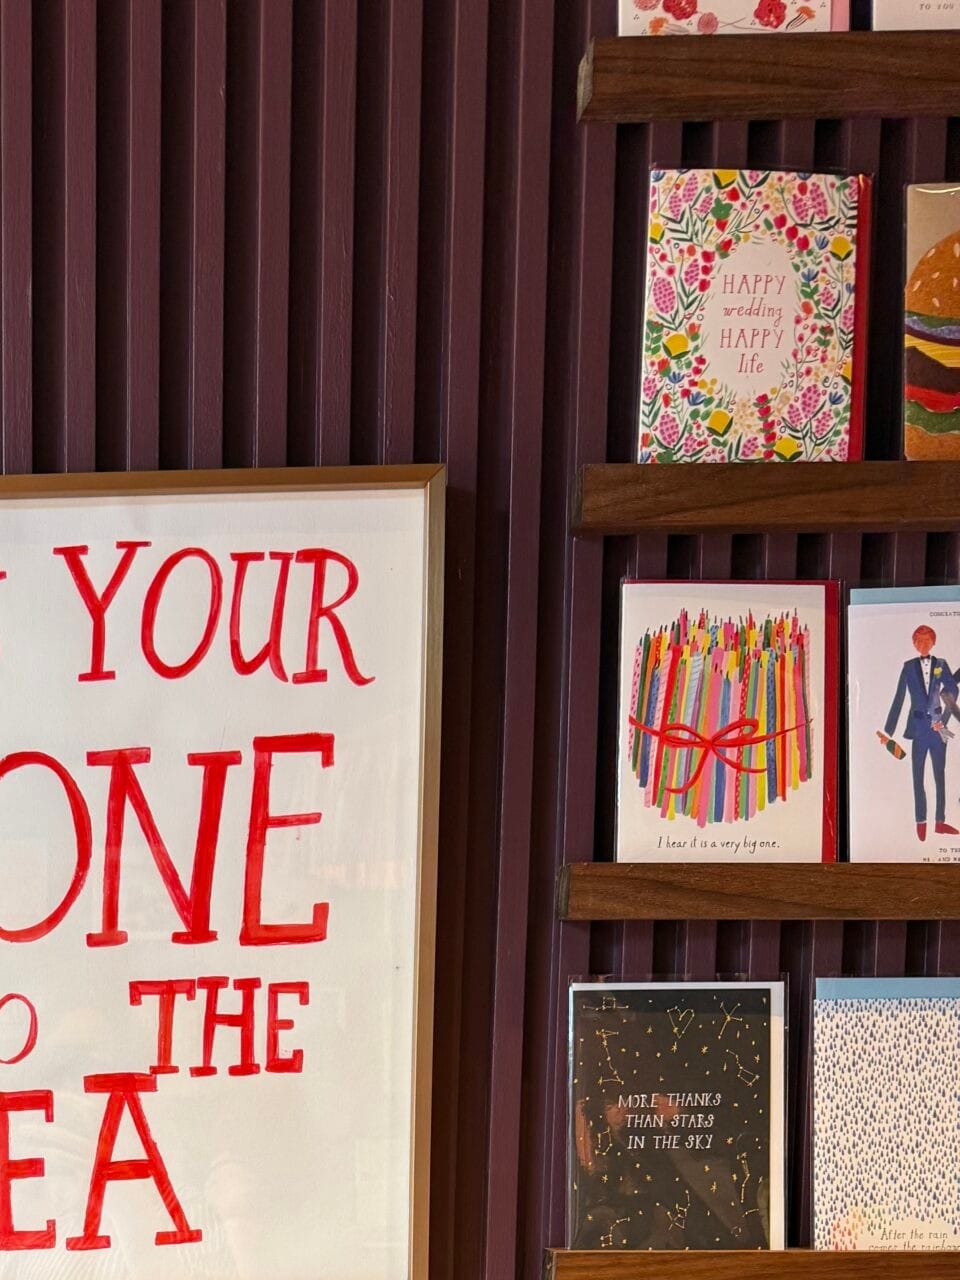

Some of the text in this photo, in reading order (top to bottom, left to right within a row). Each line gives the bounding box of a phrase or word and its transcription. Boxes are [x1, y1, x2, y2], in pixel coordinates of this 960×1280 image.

[722, 274, 786, 295] HAPPY
[723, 297, 783, 327] wedding
[720, 328, 784, 348] HAPPY
[738, 353, 764, 373] life
[53, 540, 376, 686] YOUR
[657, 836, 662, 848] I
[666, 836, 688, 848] hear
[690, 836, 697, 848] it
[700, 839, 708, 848] is
[720, 840, 741, 854] very
[743, 835, 757, 854] big
[128, 976, 311, 1078] THE
[618, 1092, 722, 1109] MORE THANKS
[625, 1113, 715, 1128] THAN STARS
[627, 1134, 713, 1150] IN THE SKY
[880, 1227, 906, 1240] After
[910, 1228, 924, 1239] the
